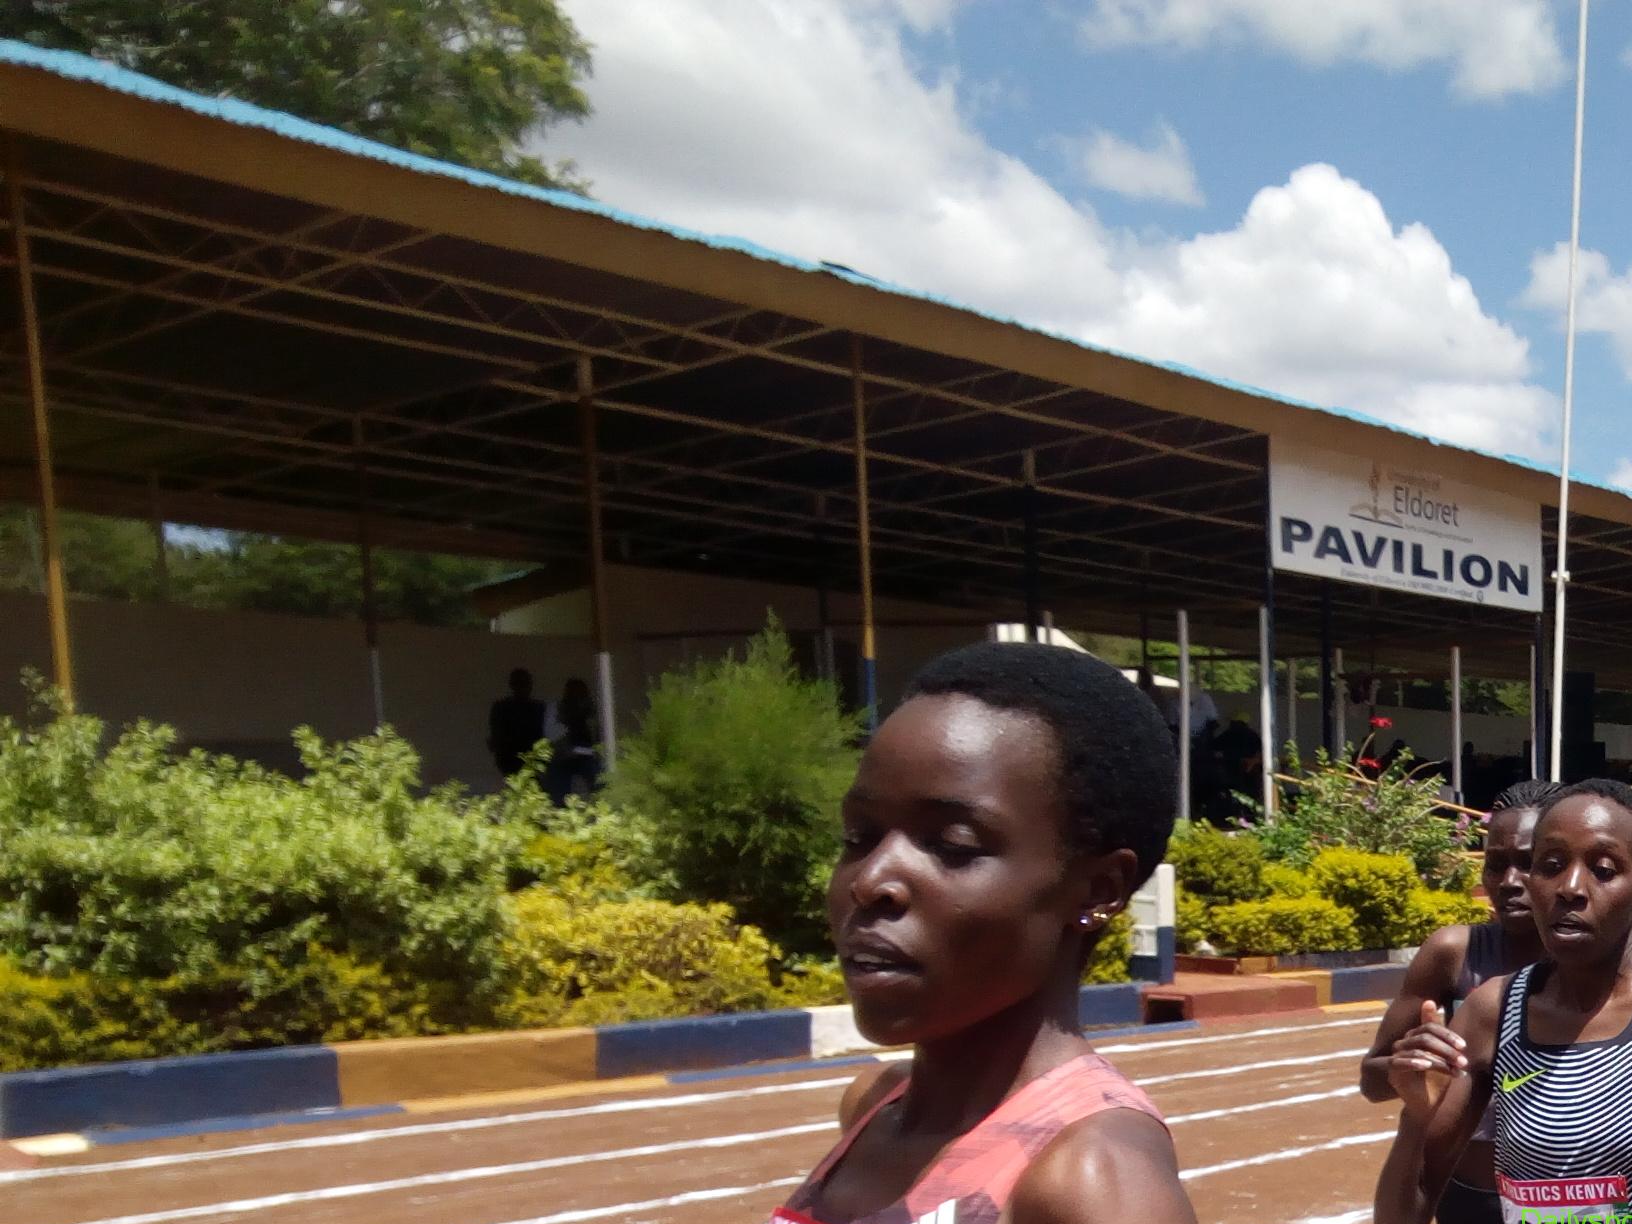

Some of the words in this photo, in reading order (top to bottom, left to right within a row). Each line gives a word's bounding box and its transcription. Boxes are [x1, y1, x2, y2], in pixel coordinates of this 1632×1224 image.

[1393, 486, 1460, 527] Eldoret
[1280, 516, 1529, 596] PAVILION
[1565, 1183, 1618, 1200] KENYA
